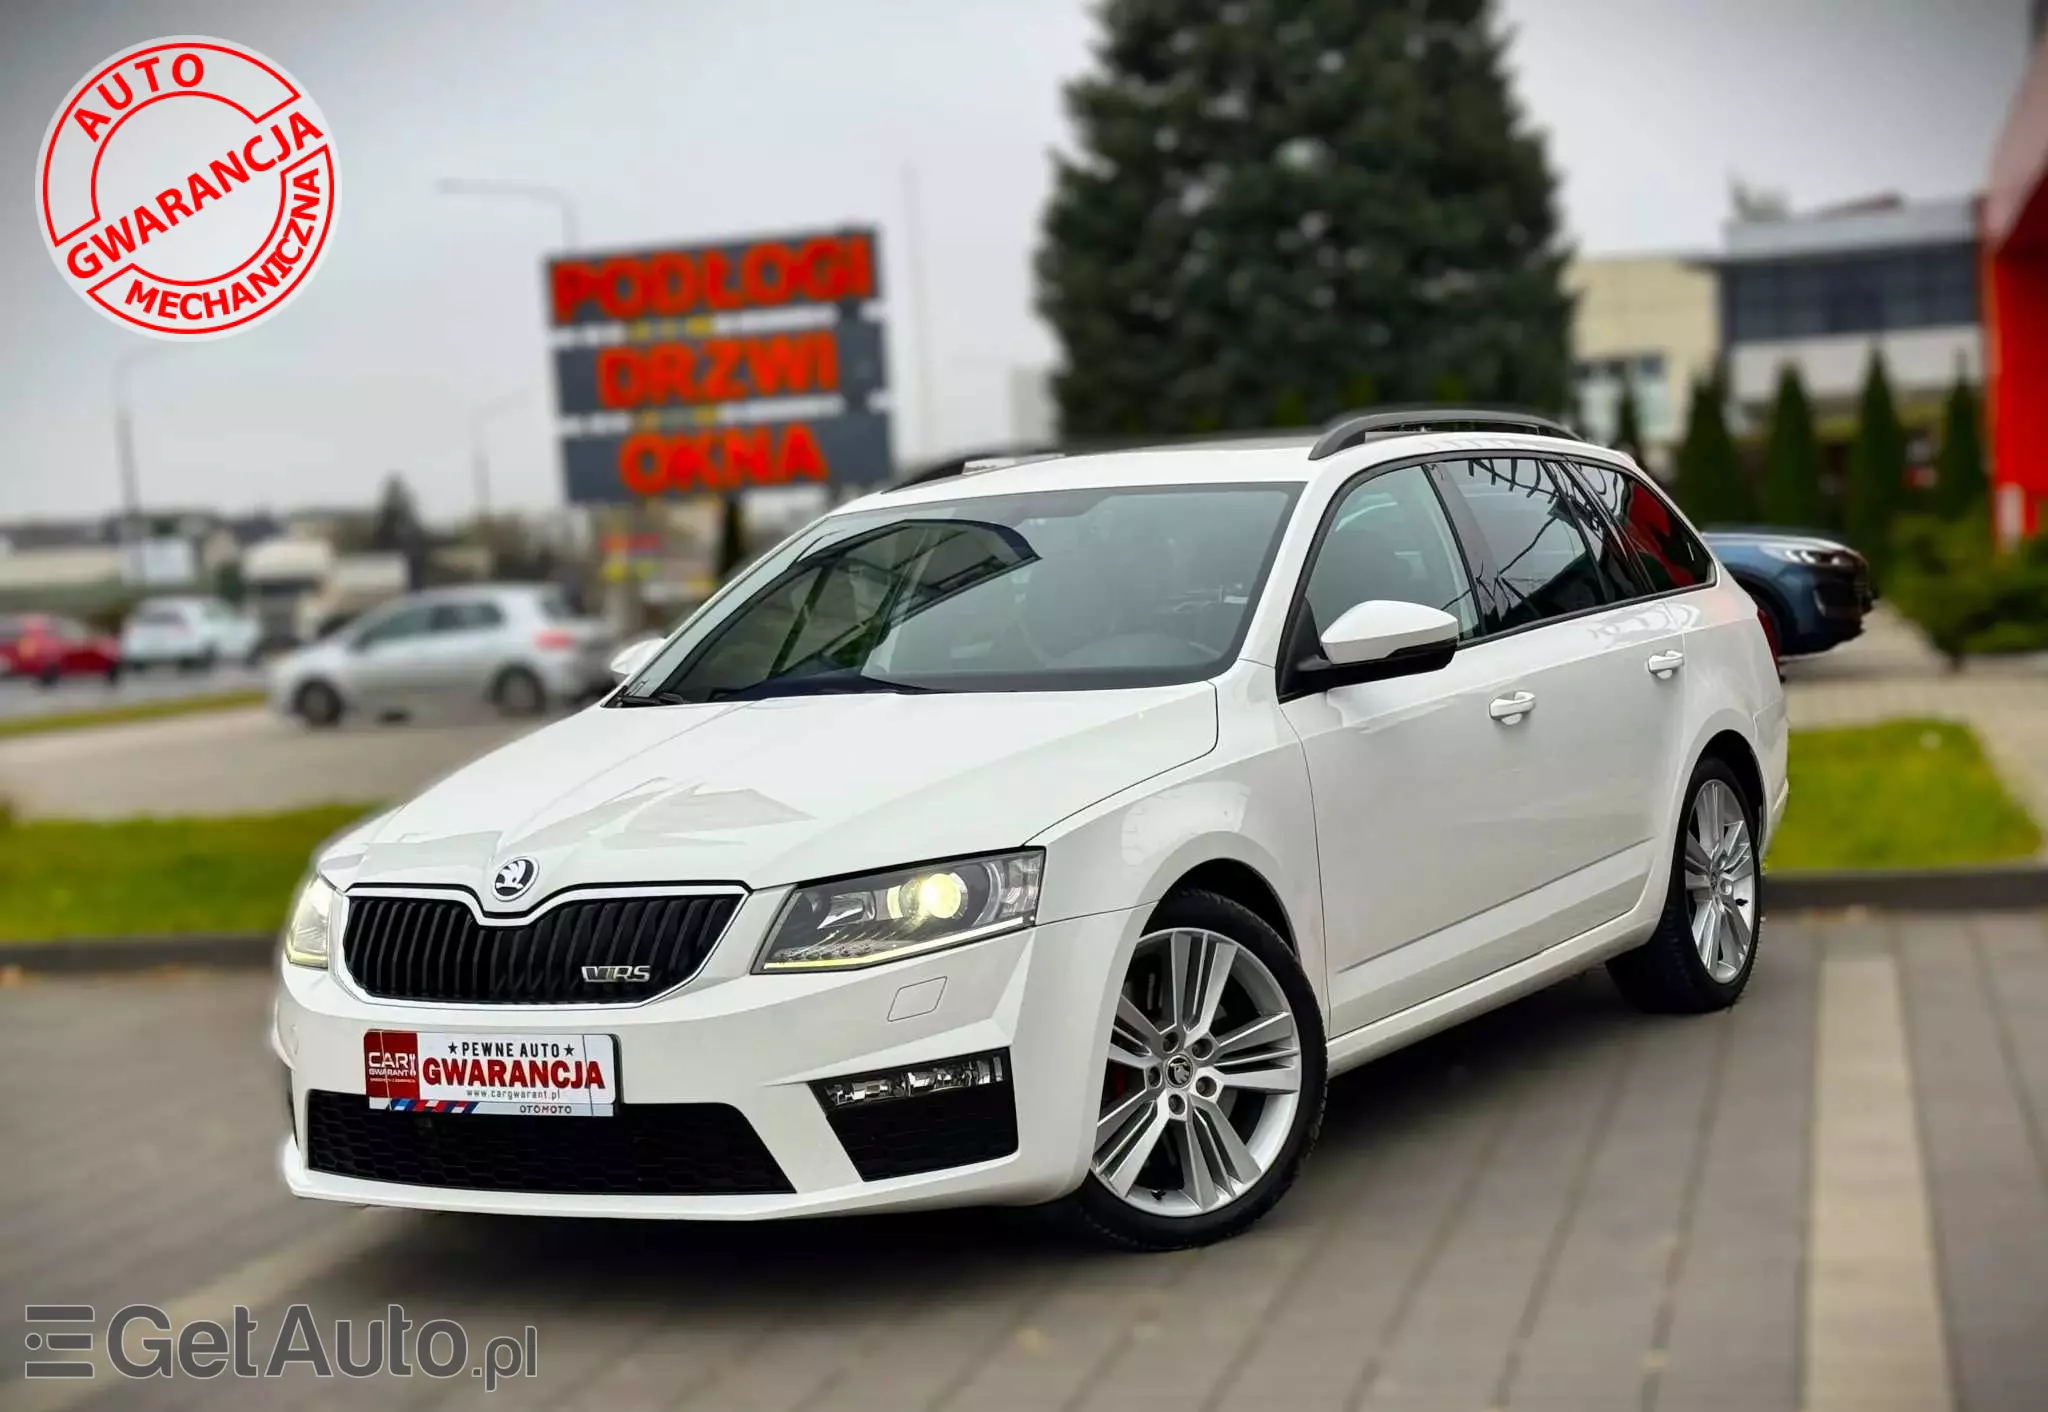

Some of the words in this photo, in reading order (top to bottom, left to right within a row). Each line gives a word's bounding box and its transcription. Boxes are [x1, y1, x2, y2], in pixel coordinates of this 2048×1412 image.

[596, 330, 839, 409] DRZWI
[618, 421, 829, 496] OKNA
[462, 1042, 514, 1057] PEWNE
[519, 1043, 560, 1058] AUTO
[369, 1052, 408, 1068] CAR
[422, 1057, 606, 1089] GWARANCJA
[466, 1089, 560, 1100] www.cargwarant.pl
[519, 1105, 572, 1114] OTOMOTO
